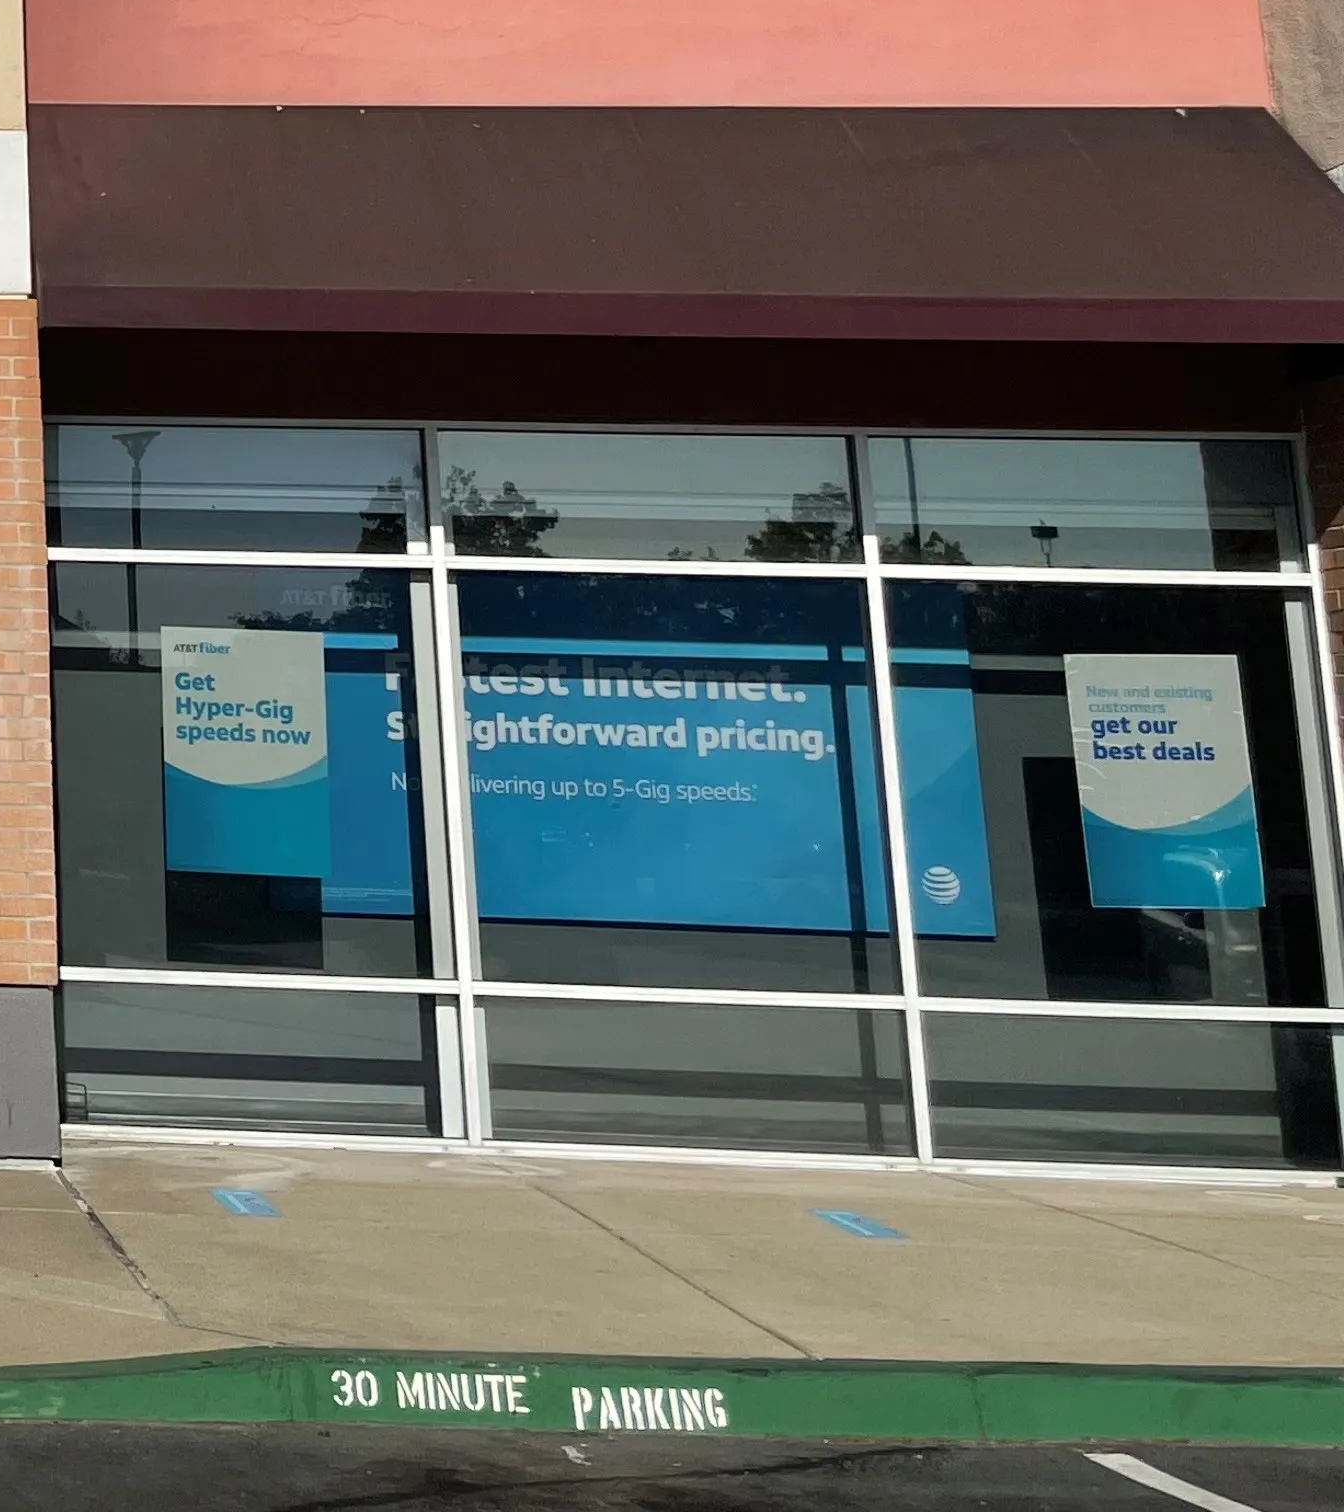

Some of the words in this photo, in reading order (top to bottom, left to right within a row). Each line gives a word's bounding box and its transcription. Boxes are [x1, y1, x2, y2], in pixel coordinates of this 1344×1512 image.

[173, 644, 197, 653] AT&T
[175, 672, 215, 691] Get
[384, 653, 570, 697] Ftest
[582, 657, 807, 703] Internet.
[1086, 685, 1118, 698] New
[1123, 686, 1150, 698] and
[1154, 686, 1213, 701] existing
[176, 696, 294, 724] Hyper-Gig
[1089, 703, 1166, 714] customers
[176, 723, 256, 745] speeds
[262, 728, 311, 745] now
[386, 711, 687, 751] Sightforward
[696, 718, 836, 761] pricing.
[1091, 716, 1131, 738] get
[1138, 719, 1177, 734] our
[1093, 740, 1146, 760] best
[1152, 741, 1215, 761] deals
[472, 773, 546, 800] livering
[552, 781, 578, 801] up
[584, 778, 607, 797] to
[612, 778, 670, 804] 5-Gig
[330, 1369, 378, 1407] 30
[396, 1371, 531, 1414] MINUTE
[571, 1386, 728, 1432] PARKING
